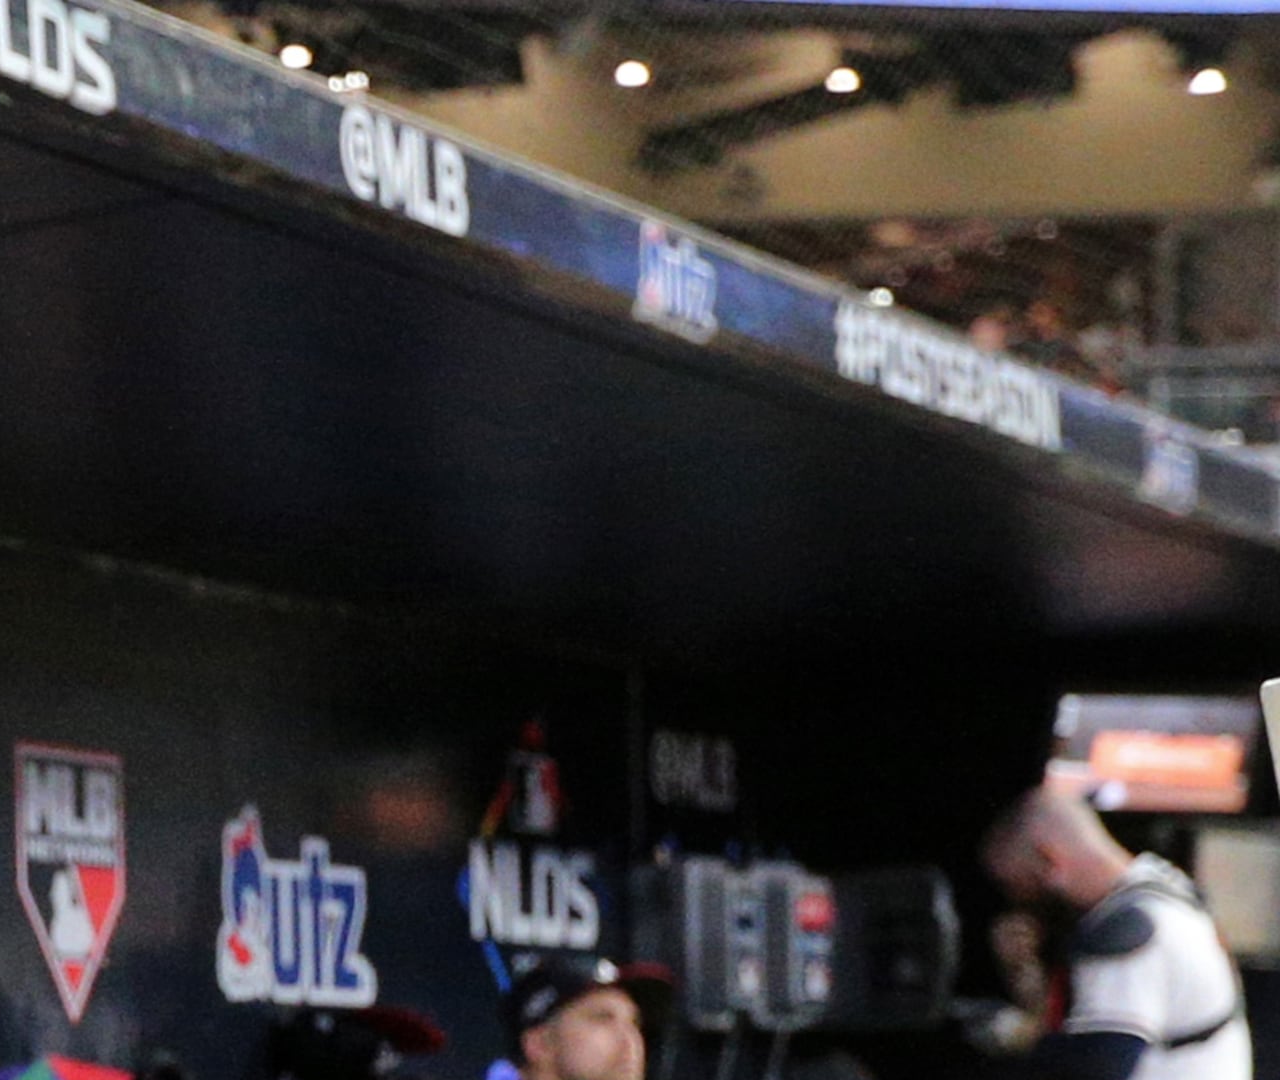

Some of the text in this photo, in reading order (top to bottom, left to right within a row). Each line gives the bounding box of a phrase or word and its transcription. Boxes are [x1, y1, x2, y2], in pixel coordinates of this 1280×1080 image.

[341, 103, 470, 238] @MLB
[23, 757, 118, 838] MLB
[468, 837, 600, 949] NLDS
